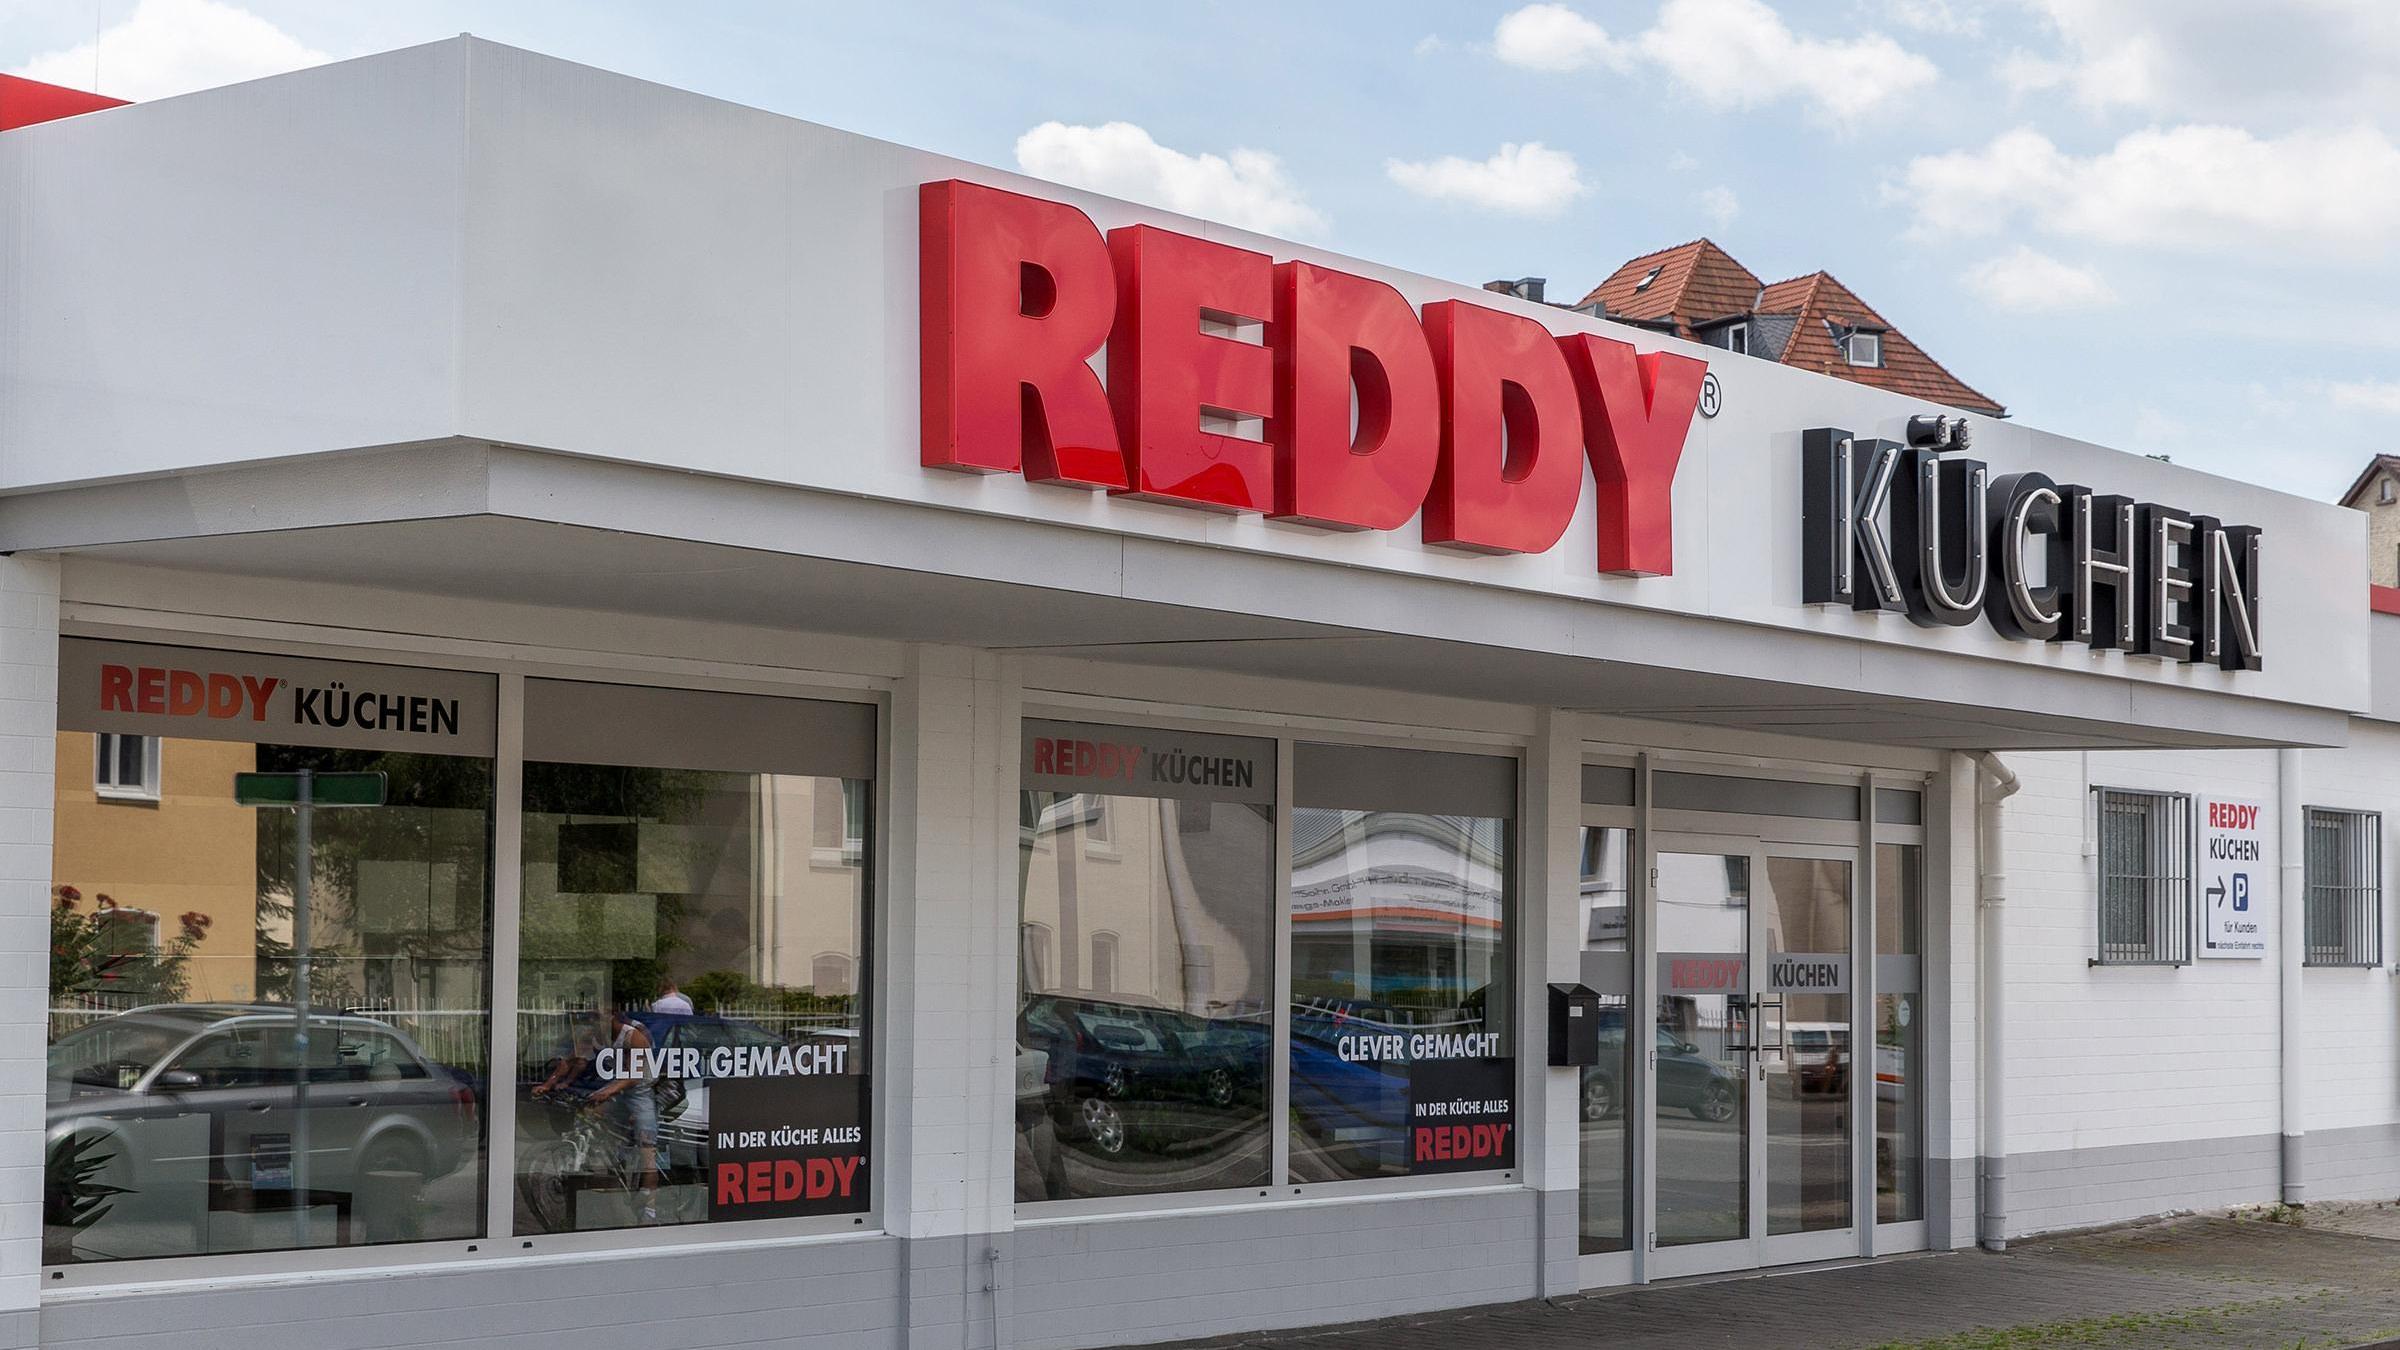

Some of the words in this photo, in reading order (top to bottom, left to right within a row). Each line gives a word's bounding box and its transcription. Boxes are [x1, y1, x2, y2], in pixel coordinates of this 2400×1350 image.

[1802, 414, 2262, 672] KÜCHEN
[294, 681, 459, 735] KÜCHEN
[1152, 748, 1253, 788] KÜCHEN
[2210, 834, 2259, 861] KÜCHEN
[2234, 920, 2257, 933] Kunden
[1773, 959, 1838, 987] KÜCHEN
[1338, 1035, 1404, 1062] CLEVER
[1410, 1032, 1499, 1060] GEMACHT
[595, 1047, 701, 1080] CLEVER
[710, 1045, 847, 1078] GEMACHT
[1415, 1103, 1427, 1117] IN
[1429, 1102, 1447, 1116] DER
[1449, 1098, 1480, 1115] KÜCHE
[1483, 1099, 1509, 1113] ALLES
[717, 1132, 734, 1149] IN
[739, 1130, 767, 1148] DER
[771, 1126, 818, 1147] KÜCHE
[822, 1127, 861, 1144] ALLES
